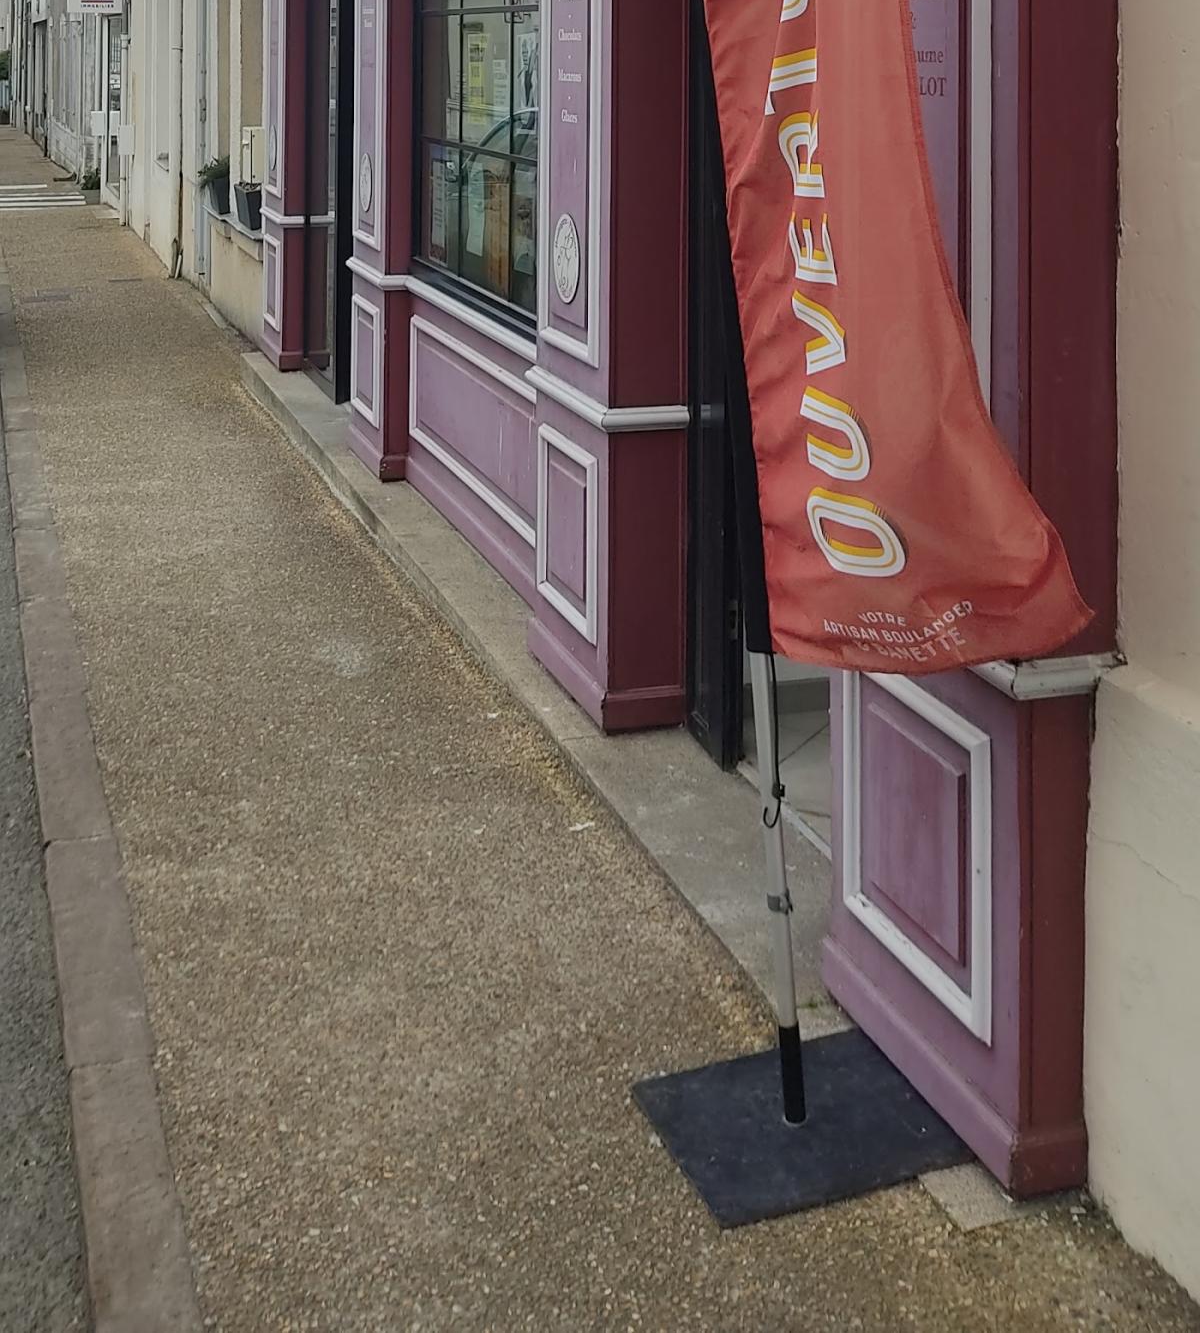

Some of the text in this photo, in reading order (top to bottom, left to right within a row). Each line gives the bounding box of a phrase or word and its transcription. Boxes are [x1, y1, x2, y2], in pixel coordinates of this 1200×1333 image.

[919, 76, 947, 97] LOT
[823, 618, 880, 641] ARTISAN
[857, 611, 906, 627] VOTRE
